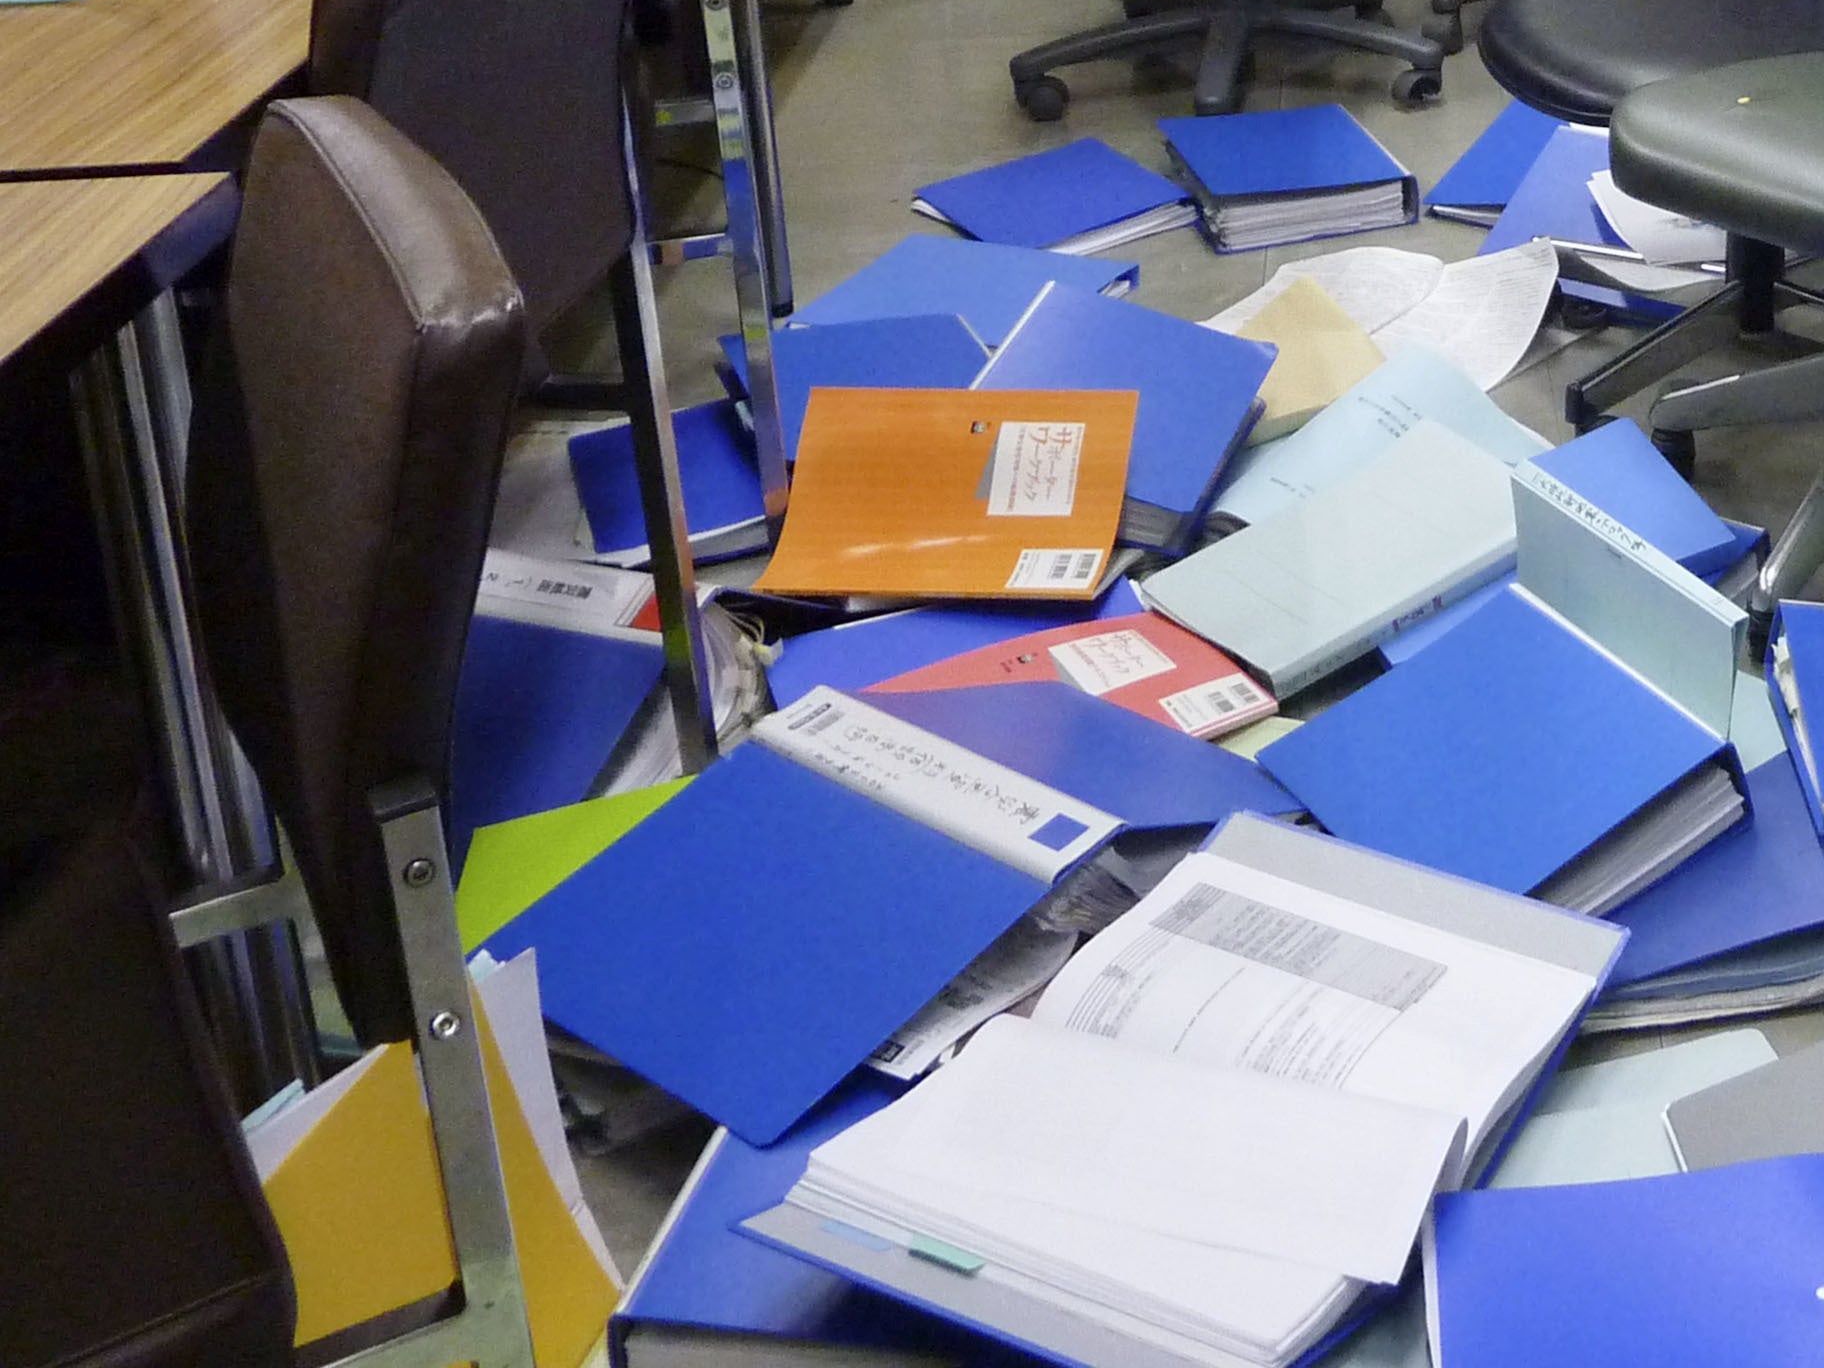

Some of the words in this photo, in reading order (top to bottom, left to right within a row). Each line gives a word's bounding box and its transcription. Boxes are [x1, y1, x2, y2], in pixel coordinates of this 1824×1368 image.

[1043, 425, 1073, 502] サポーター
